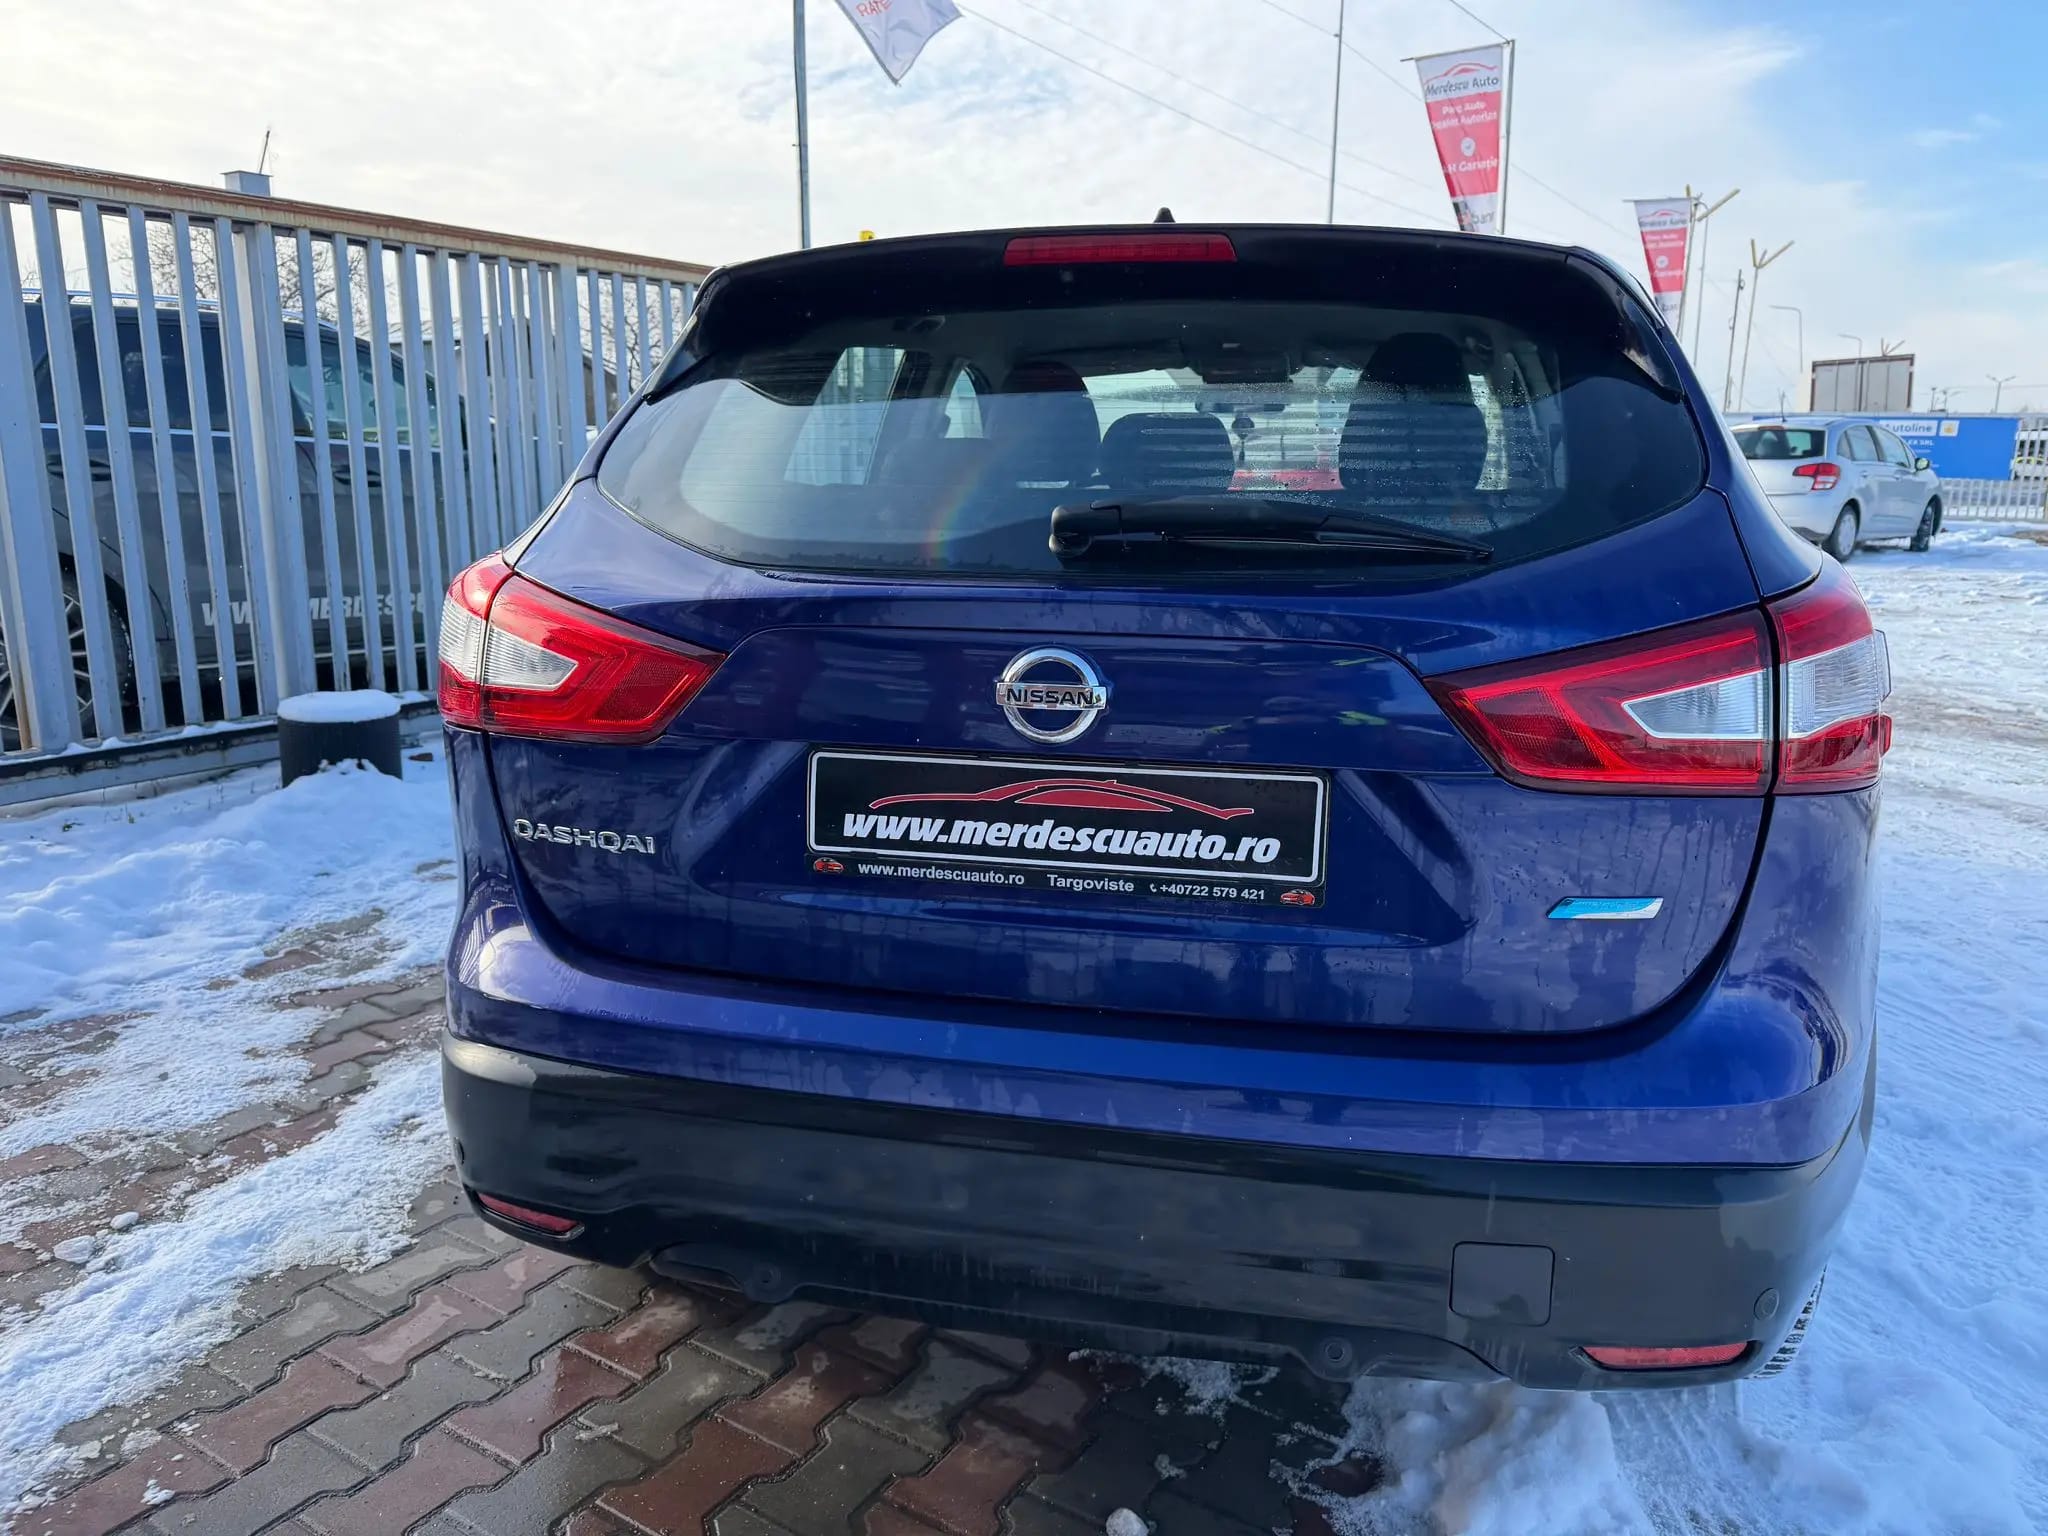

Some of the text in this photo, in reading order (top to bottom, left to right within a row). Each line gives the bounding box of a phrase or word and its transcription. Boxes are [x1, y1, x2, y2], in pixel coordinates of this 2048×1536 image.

[1472, 76, 1498, 88] Auto
[1886, 423, 1933, 432] utoline
[1007, 688, 1093, 705] NISSAN
[514, 818, 656, 855] QASHQAI
[843, 813, 1281, 863] www.merdescuauto.ro
[857, 863, 1265, 900] www.merdescuauto.ro Targoviste +40722 579 421
